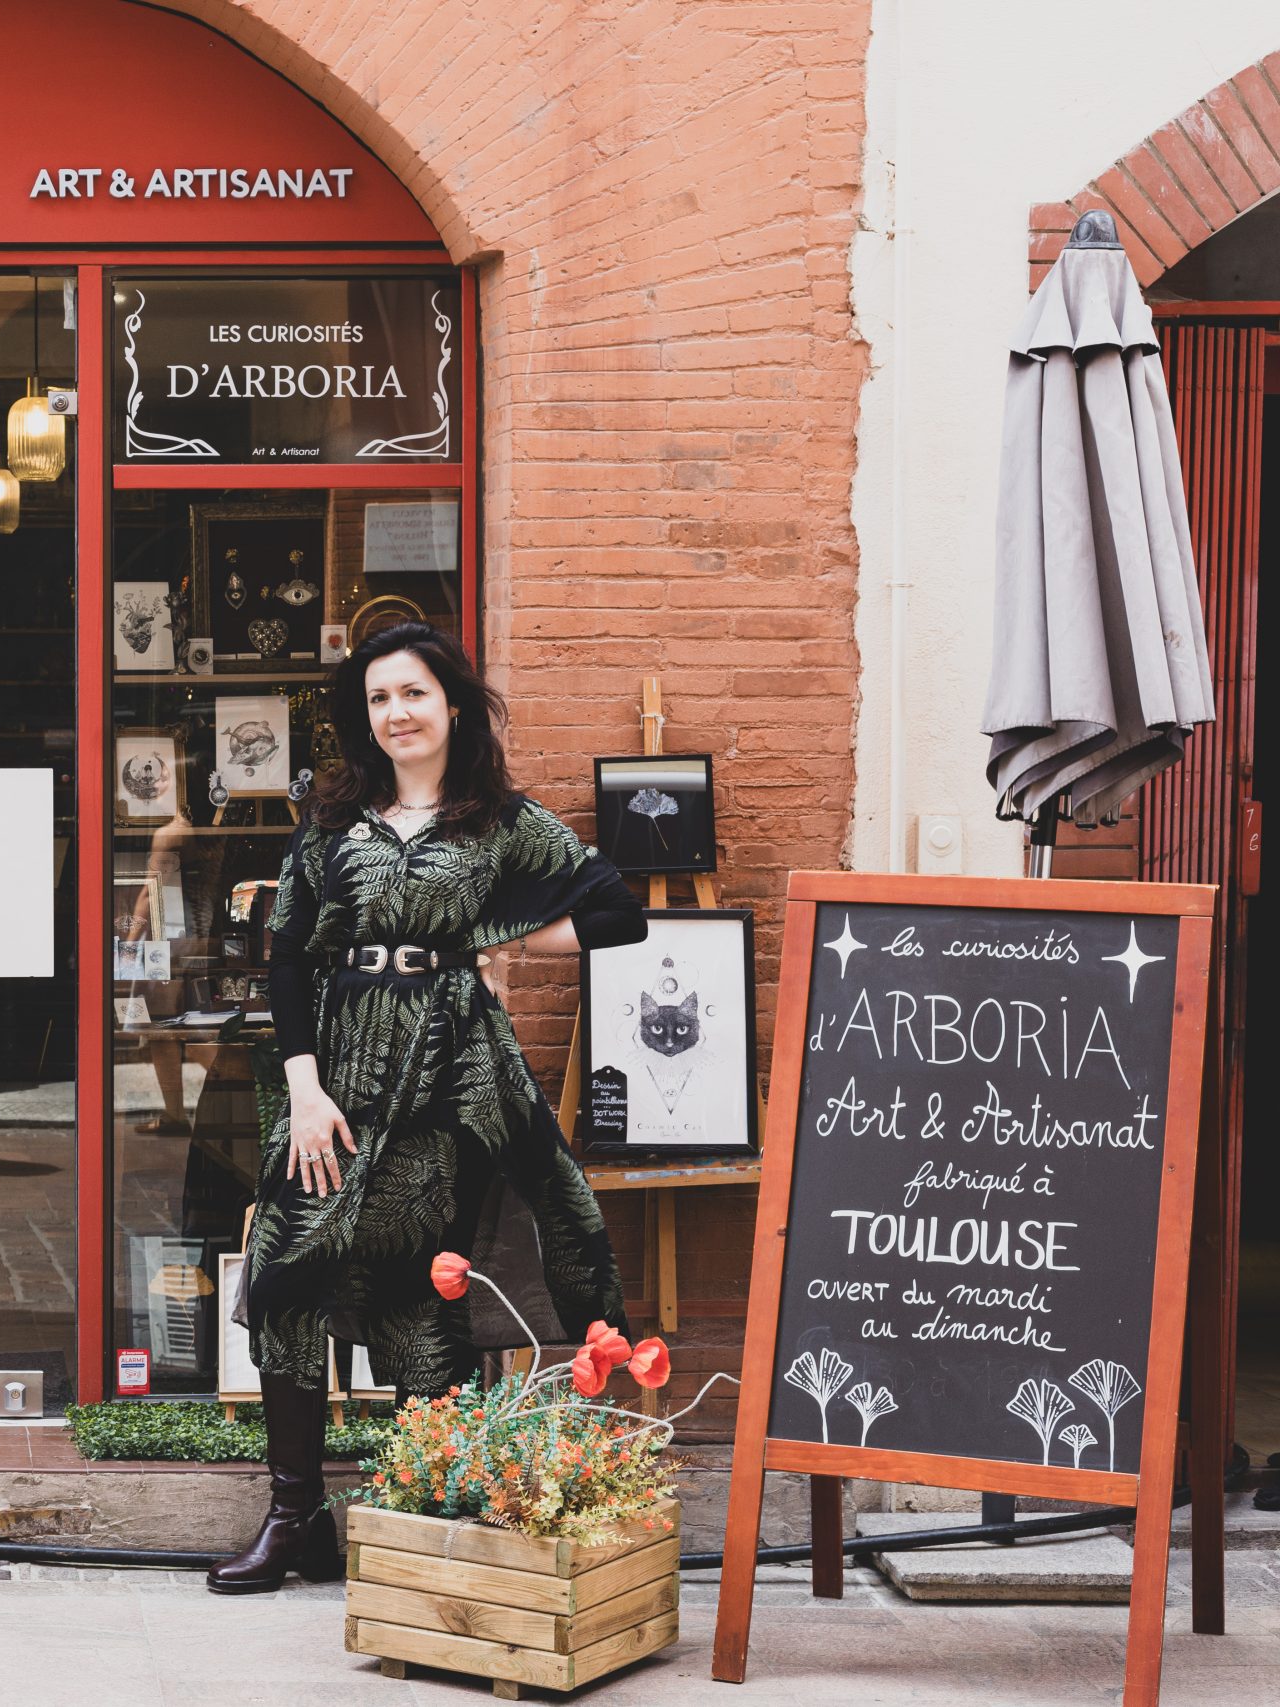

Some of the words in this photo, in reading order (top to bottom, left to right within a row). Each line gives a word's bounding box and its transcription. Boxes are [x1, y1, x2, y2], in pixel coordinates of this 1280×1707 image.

[30, 167, 102, 198] ART
[109, 168, 135, 198] &
[144, 167, 353, 198] ARTISANAT
[209, 325, 241, 343] LES
[247, 321, 364, 343] CURIOSITÉS
[166, 363, 408, 399] D'ARBORIA
[252, 447, 265, 456] Art
[269, 448, 277, 456] &
[280, 447, 320, 456] Artisanat
[881, 927, 925, 958] les
[942, 928, 1080, 964] curiosités
[816, 1076, 907, 1140] Art
[921, 1092, 946, 1139] &
[961, 1080, 1159, 1150] Artisanat
[903, 1160, 1027, 1210] fabriqué
[1033, 1164, 1056, 1196] à
[830, 1209, 1081, 1271] TOULOUSE
[902, 1278, 936, 1305] du
[946, 1283, 1052, 1313] mardi
[861, 1318, 898, 1338] au
[911, 1305, 1067, 1352] dimanche
